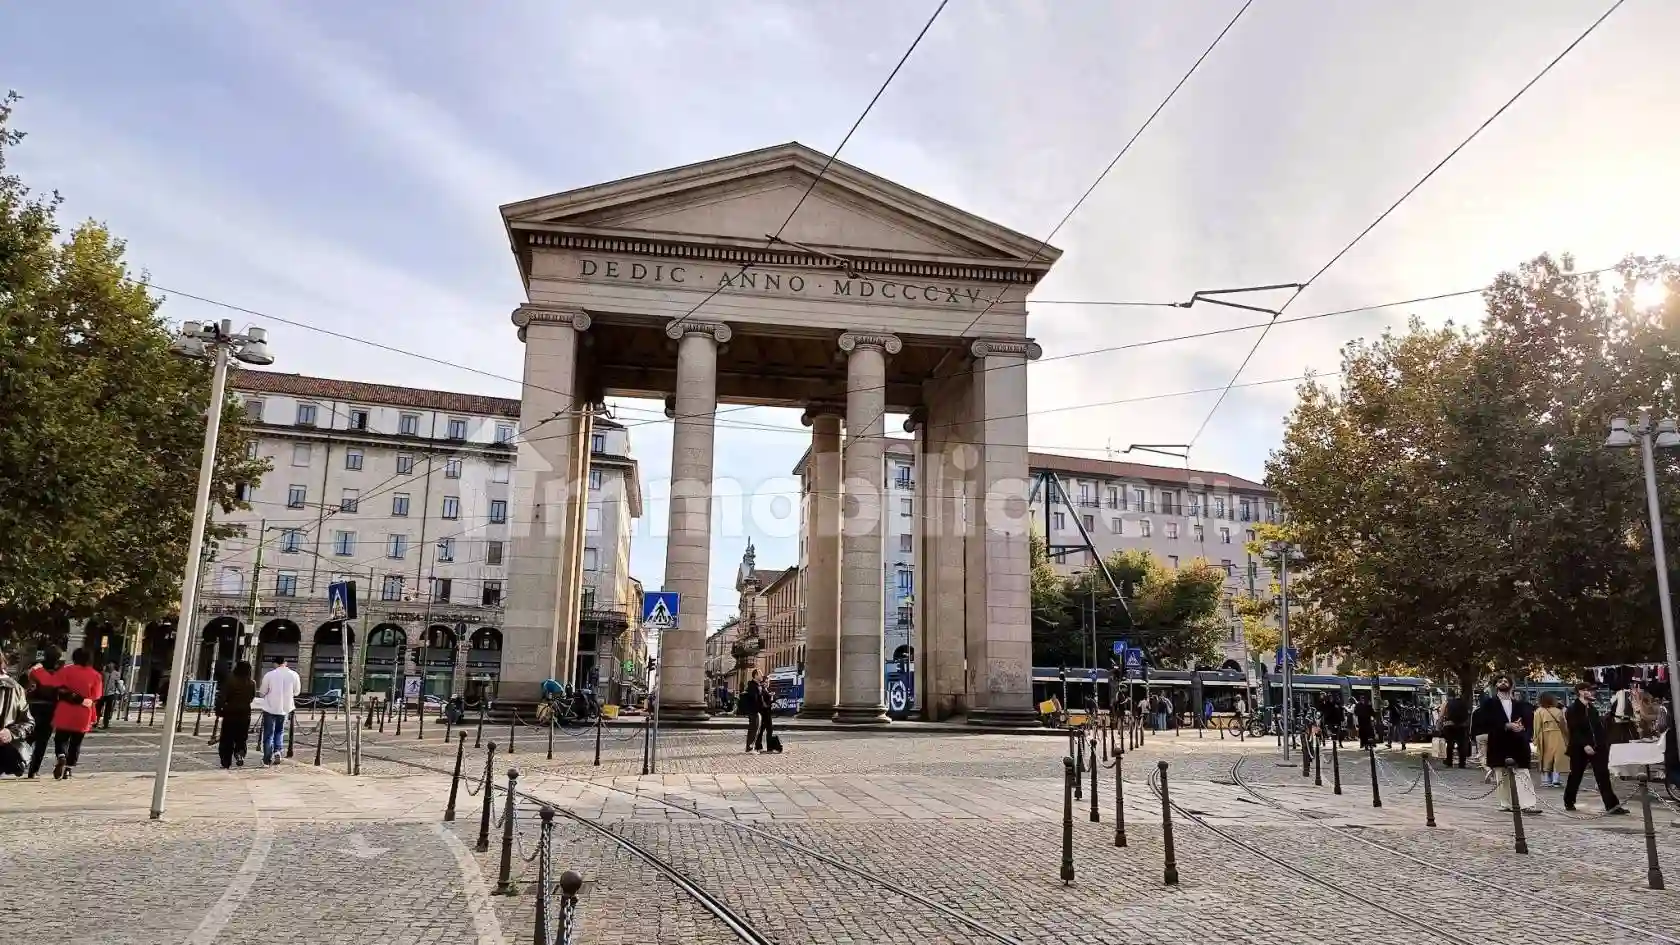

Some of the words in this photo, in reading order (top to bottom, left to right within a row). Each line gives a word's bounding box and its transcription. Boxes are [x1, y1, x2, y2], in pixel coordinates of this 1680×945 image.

[581, 258, 687, 284] DEDIC
[718, 270, 805, 293] ANNO
[832, 278, 981, 304] MDCCCXV
